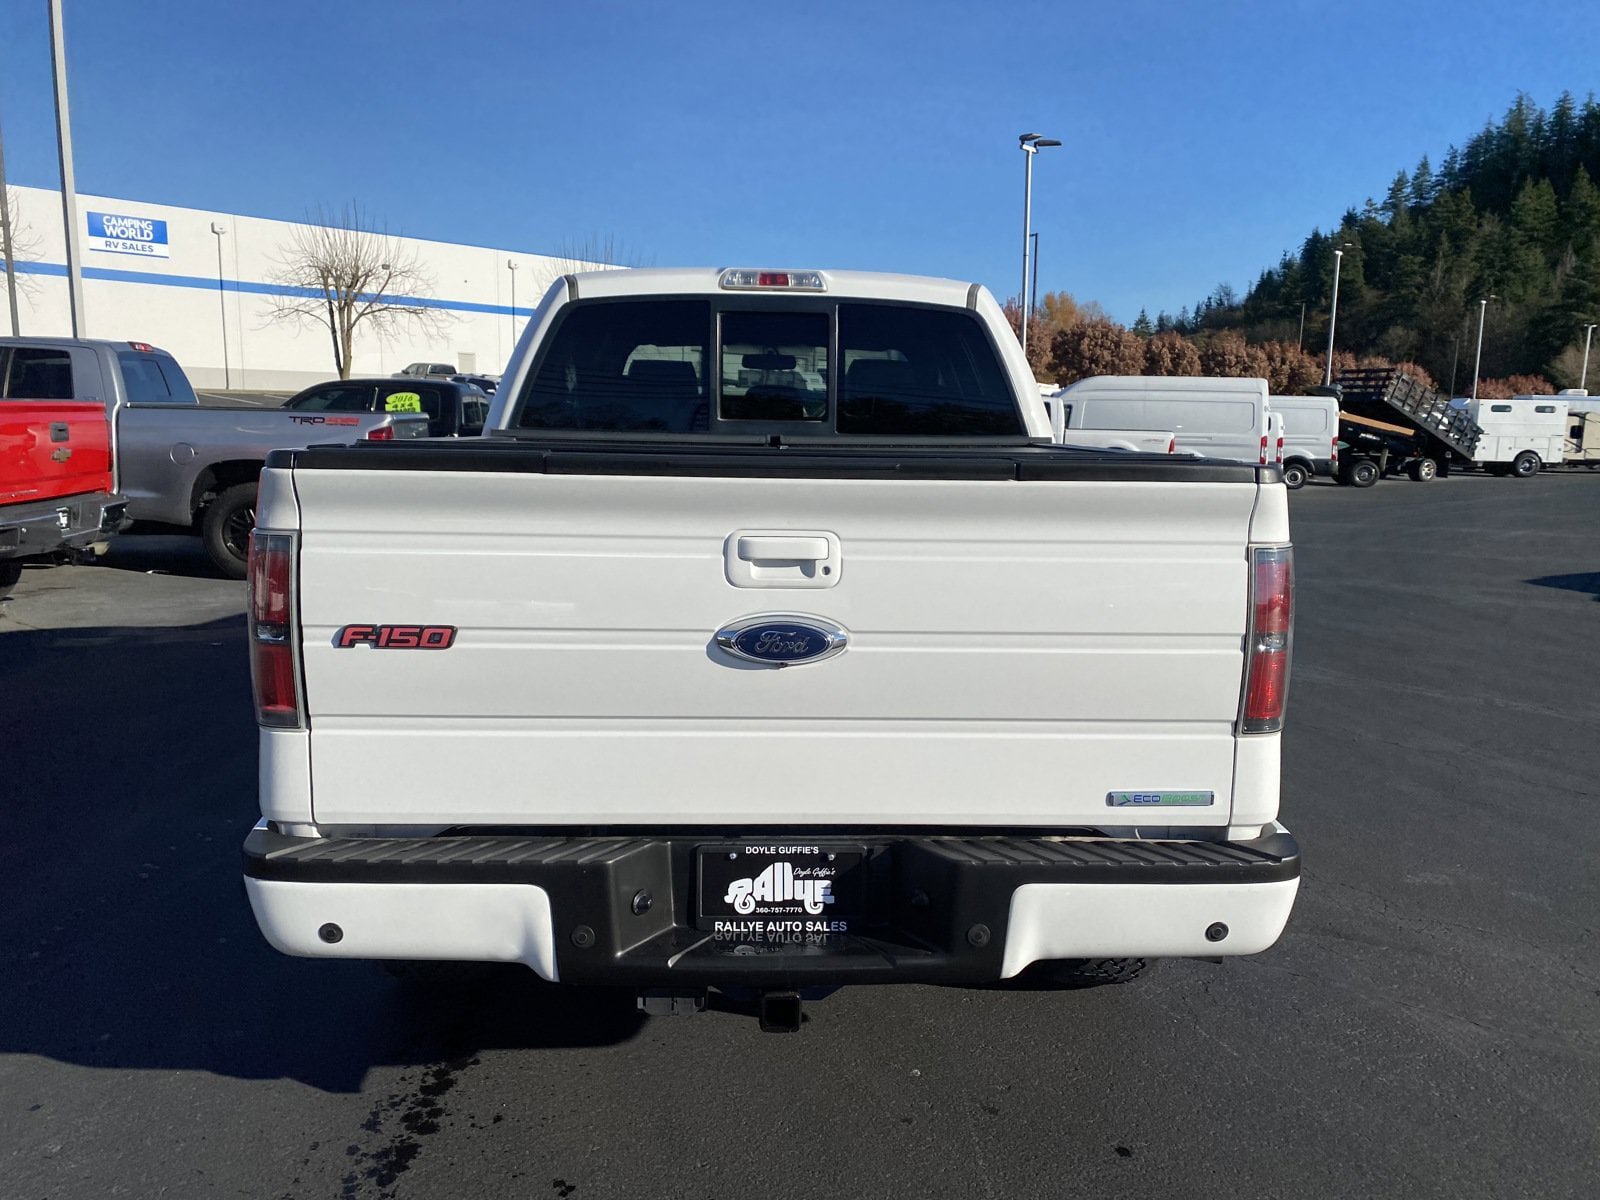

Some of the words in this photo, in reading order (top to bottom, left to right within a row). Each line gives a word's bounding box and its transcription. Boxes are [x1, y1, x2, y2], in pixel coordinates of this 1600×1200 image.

[103, 216, 153, 231] CAMPING
[104, 225, 153, 241] WORLD
[105, 240, 119, 249] RV
[122, 242, 154, 252] SALES
[288, 416, 325, 425] TRD
[341, 626, 454, 648] F-150
[754, 630, 809, 654] Ford
[745, 846, 776, 854] DOYLE
[778, 846, 819, 854] GUFFIE'S
[714, 921, 764, 932] RALLYE
[766, 921, 802, 932] AUTO
[805, 921, 847, 932] SALES
